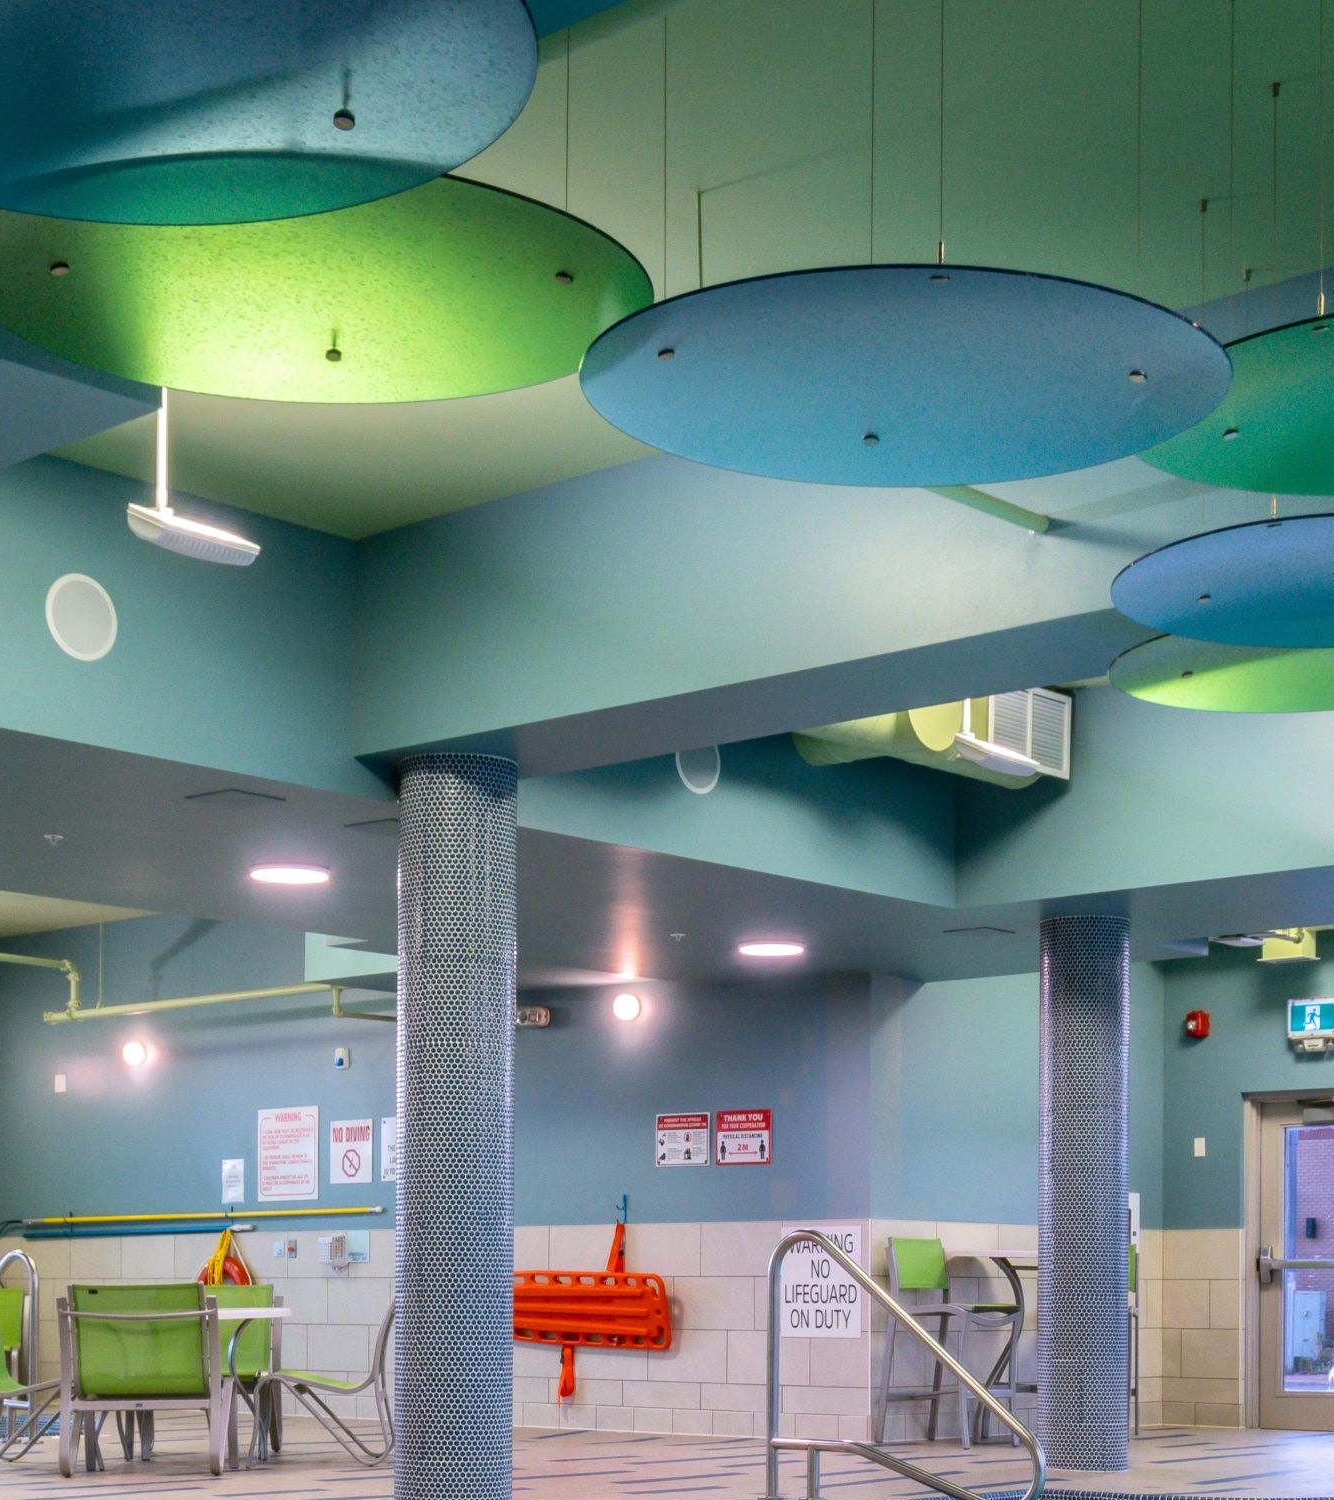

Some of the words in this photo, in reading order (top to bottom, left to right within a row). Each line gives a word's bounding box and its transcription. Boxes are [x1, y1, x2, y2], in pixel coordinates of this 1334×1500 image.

[275, 1112, 301, 1122] WARNING
[333, 1128, 343, 1143] NO
[346, 1126, 370, 1142] DIVING
[811, 1259, 830, 1278] NO
[785, 1284, 857, 1303] LIFEGUARD
[791, 1309, 809, 1328] ON
[815, 1309, 851, 1328] DUTY
